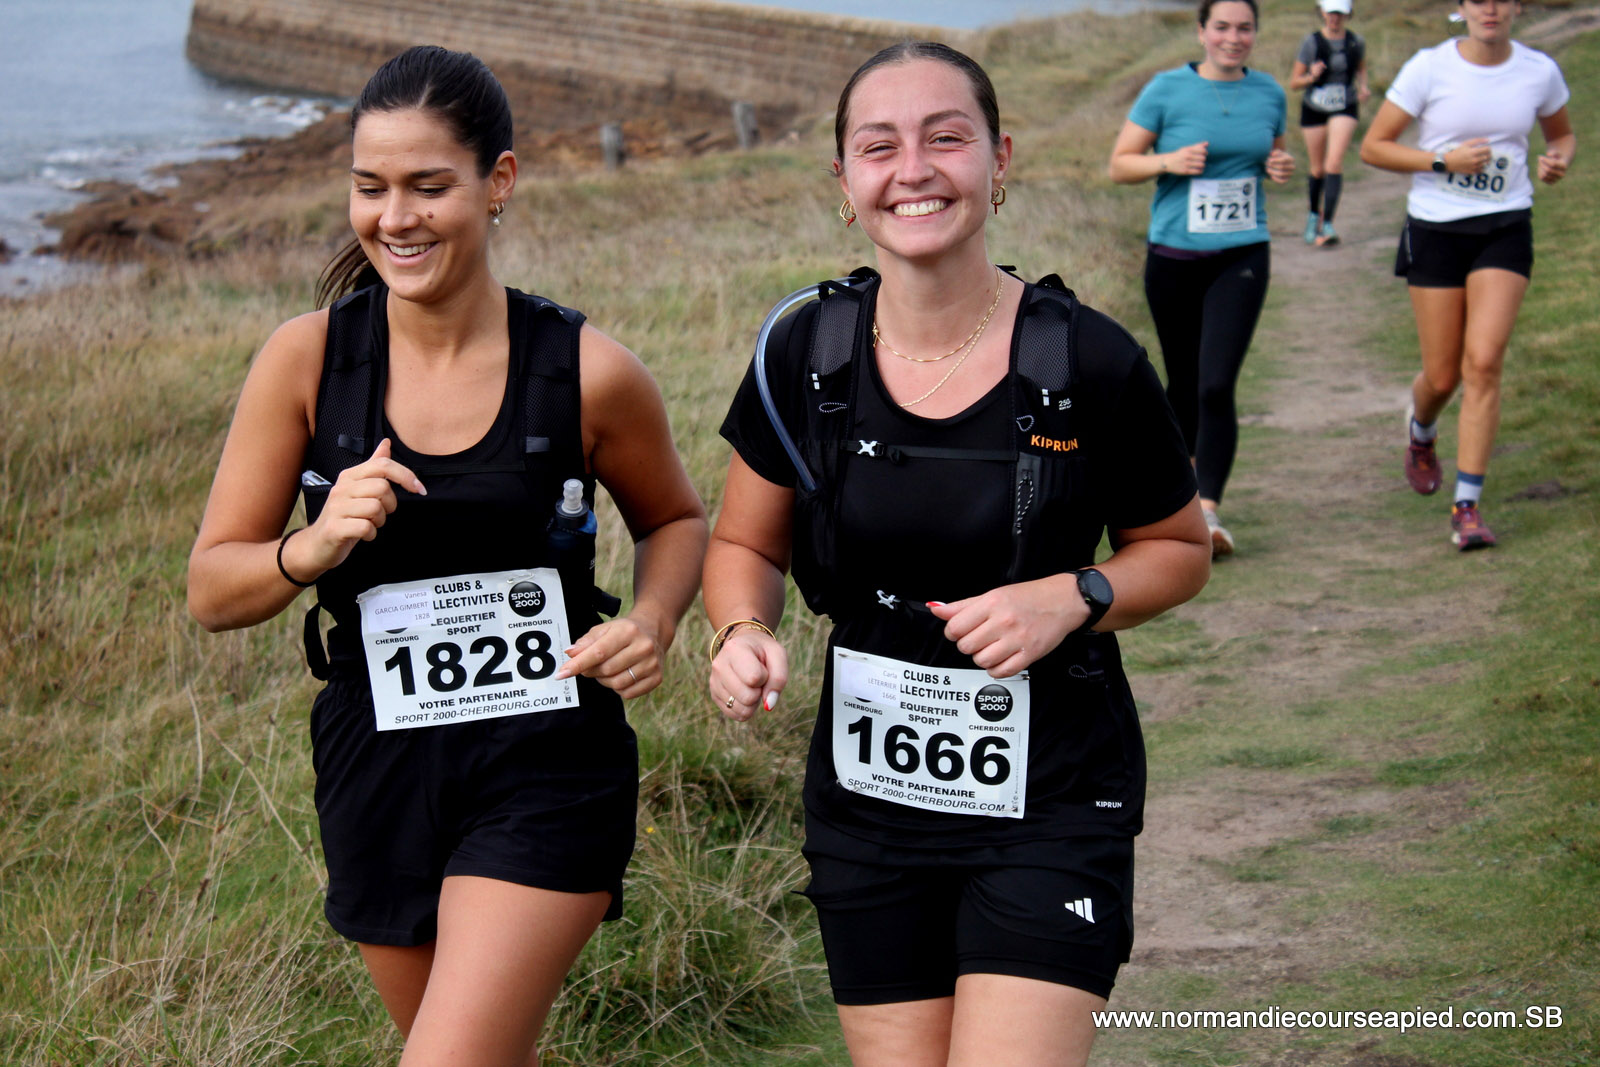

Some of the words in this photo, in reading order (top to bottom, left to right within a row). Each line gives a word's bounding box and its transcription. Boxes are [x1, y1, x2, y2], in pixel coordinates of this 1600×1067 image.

[1447, 172, 1505, 193] 1380
[1197, 201, 1250, 220] 1721
[1031, 434, 1079, 451] KIPRUN
[434, 581, 471, 594] CLUBS
[475, 580, 483, 590] &
[405, 591, 427, 599] Vanesa
[433, 592, 505, 610] LLECTIVITES
[511, 591, 542, 600] SPORT
[375, 607, 399, 615] GARCIA
[400, 602, 428, 611] GIMBERT
[515, 599, 541, 608] 2000
[447, 625, 482, 636] SPORT
[508, 619, 553, 629] CHERBOURG
[375, 635, 419, 645] CHERBOURG
[384, 630, 557, 696] 1828
[903, 669, 939, 684] CLUBS
[943, 675, 951, 685] &
[419, 699, 455, 710] VOTRE
[459, 689, 528, 705] PARTENAIRE
[900, 683, 970, 702] LLECTIVITES
[978, 695, 1010, 703] SPORT
[395, 713, 430, 724] SPORT
[433, 696, 559, 721] 2000-CHERBOURG.COM
[844, 701, 883, 715] CHERBOURG
[900, 701, 959, 717] EQUERTIER
[980, 703, 1007, 711] 2000
[908, 714, 942, 726] SPORT
[848, 715, 1011, 786] 1666
[872, 773, 904, 788] VOTRE
[908, 778, 976, 798] PARTENAIRE
[847, 778, 880, 792] SPORT
[882, 787, 1006, 812] 2000-CHERBOURG.COM
[1095, 800, 1122, 808] KIPRUN
